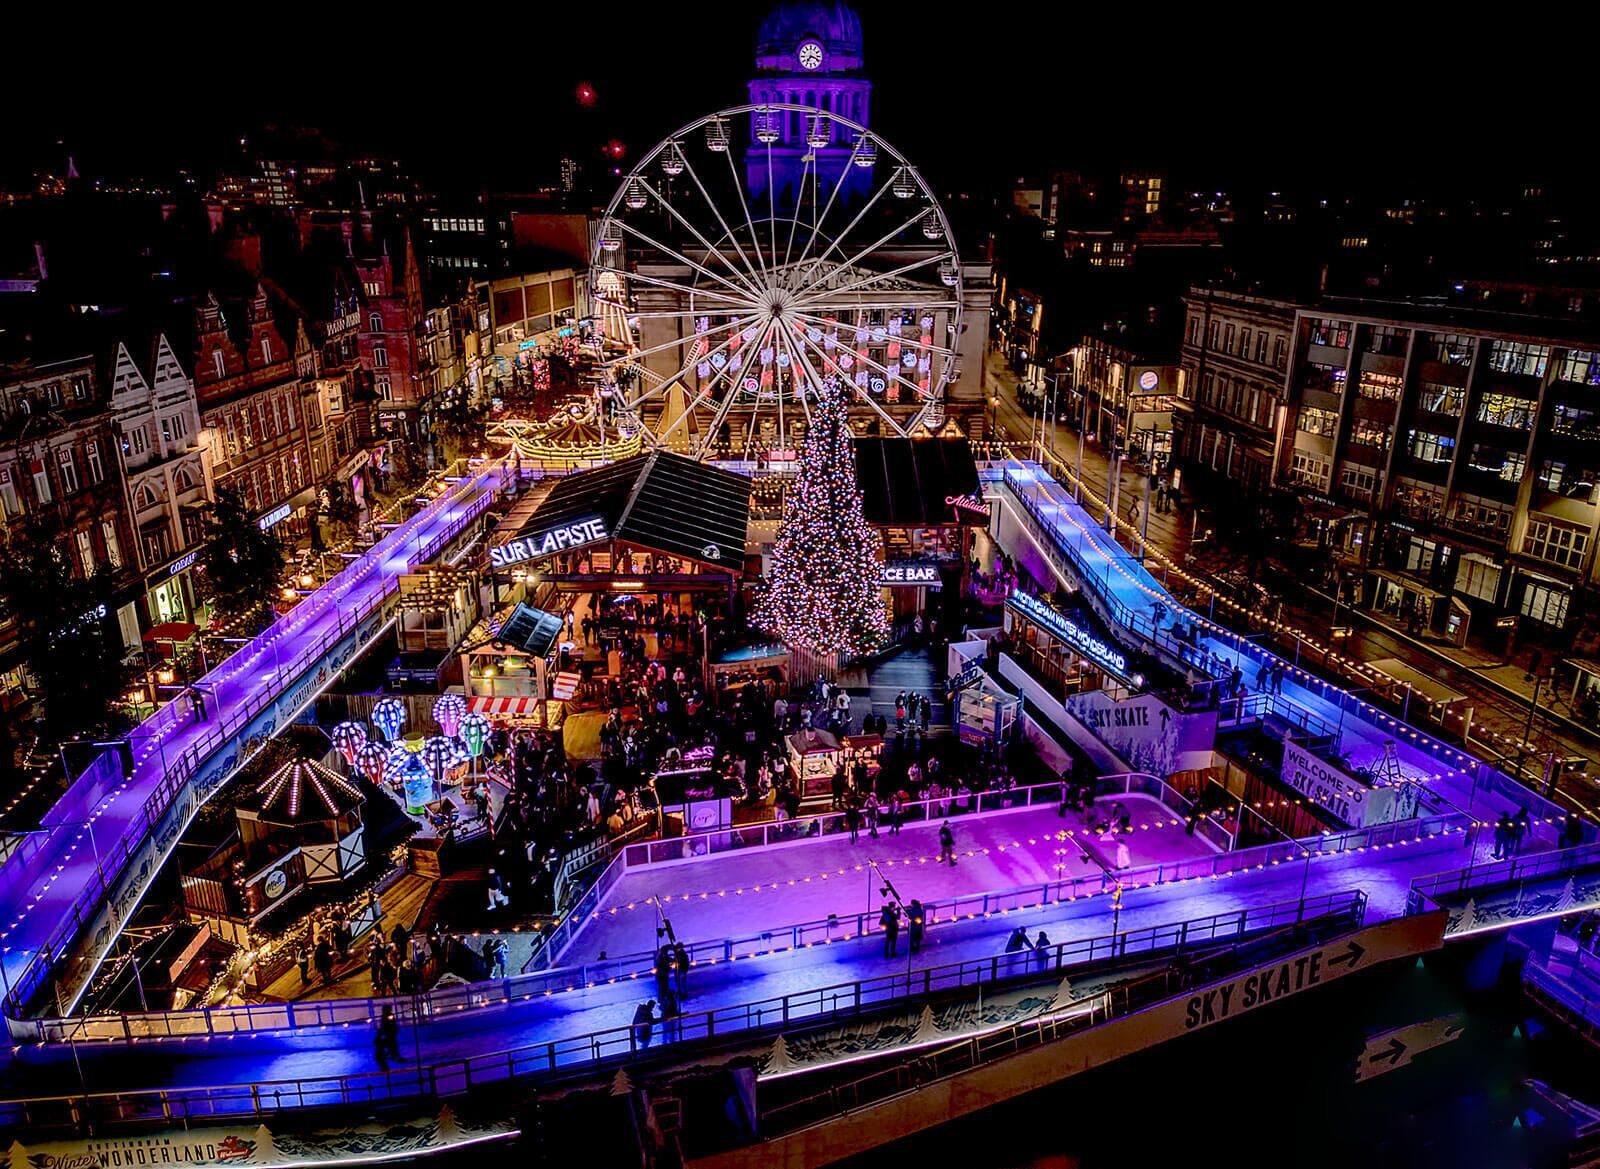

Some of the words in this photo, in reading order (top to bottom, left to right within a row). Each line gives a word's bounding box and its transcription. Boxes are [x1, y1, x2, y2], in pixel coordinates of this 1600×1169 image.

[490, 540, 530, 567] SUR
[906, 567, 935, 580] BAR
[1093, 708, 1111, 728] SKY
[1114, 706, 1149, 727] SKATE
[1288, 749, 1344, 792] WELCOME
[1293, 771, 1314, 795] SKY
[1315, 785, 1349, 819] SKATE
[1185, 983, 1236, 1029] SKY
[1243, 951, 1324, 1009] SKATE
[44, 1153, 99, 1169] Winter
[97, 1144, 217, 1168] WONDERLAND
